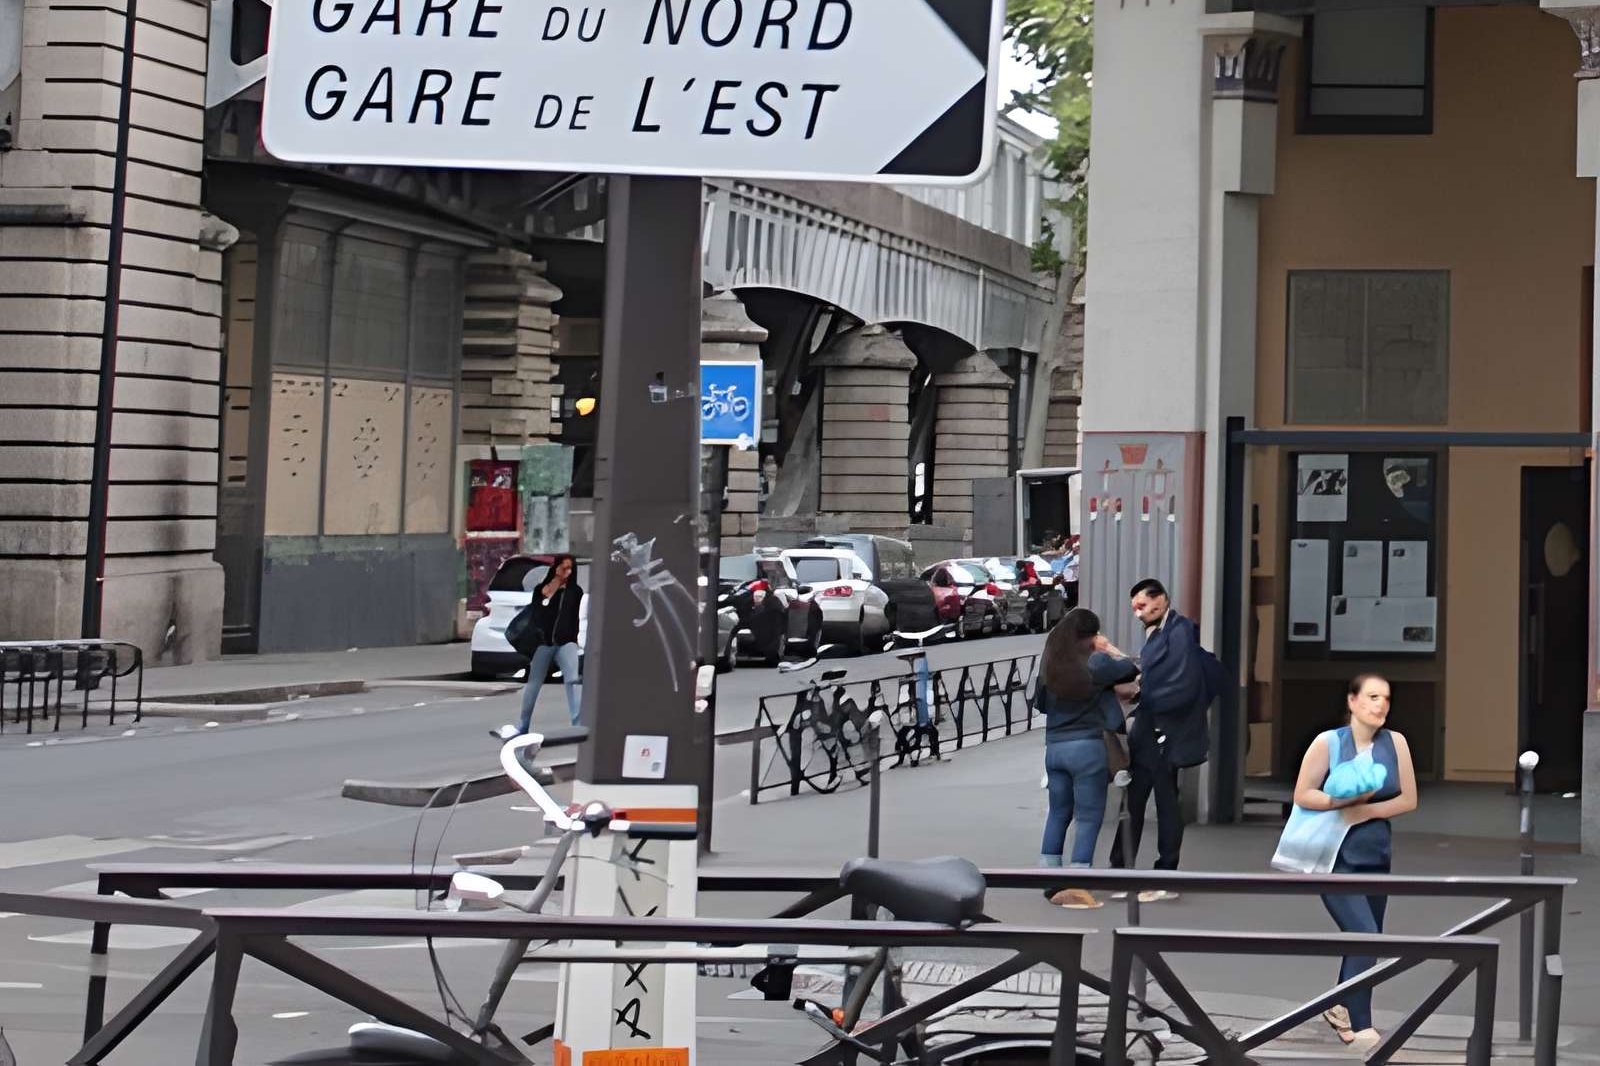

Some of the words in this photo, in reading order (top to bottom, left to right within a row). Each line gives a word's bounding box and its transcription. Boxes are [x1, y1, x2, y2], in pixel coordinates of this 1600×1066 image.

[541, 6, 606, 43] DU
[304, 64, 502, 126] GARE
[533, 94, 594, 130] DE
[631, 76, 841, 140] L'EST
